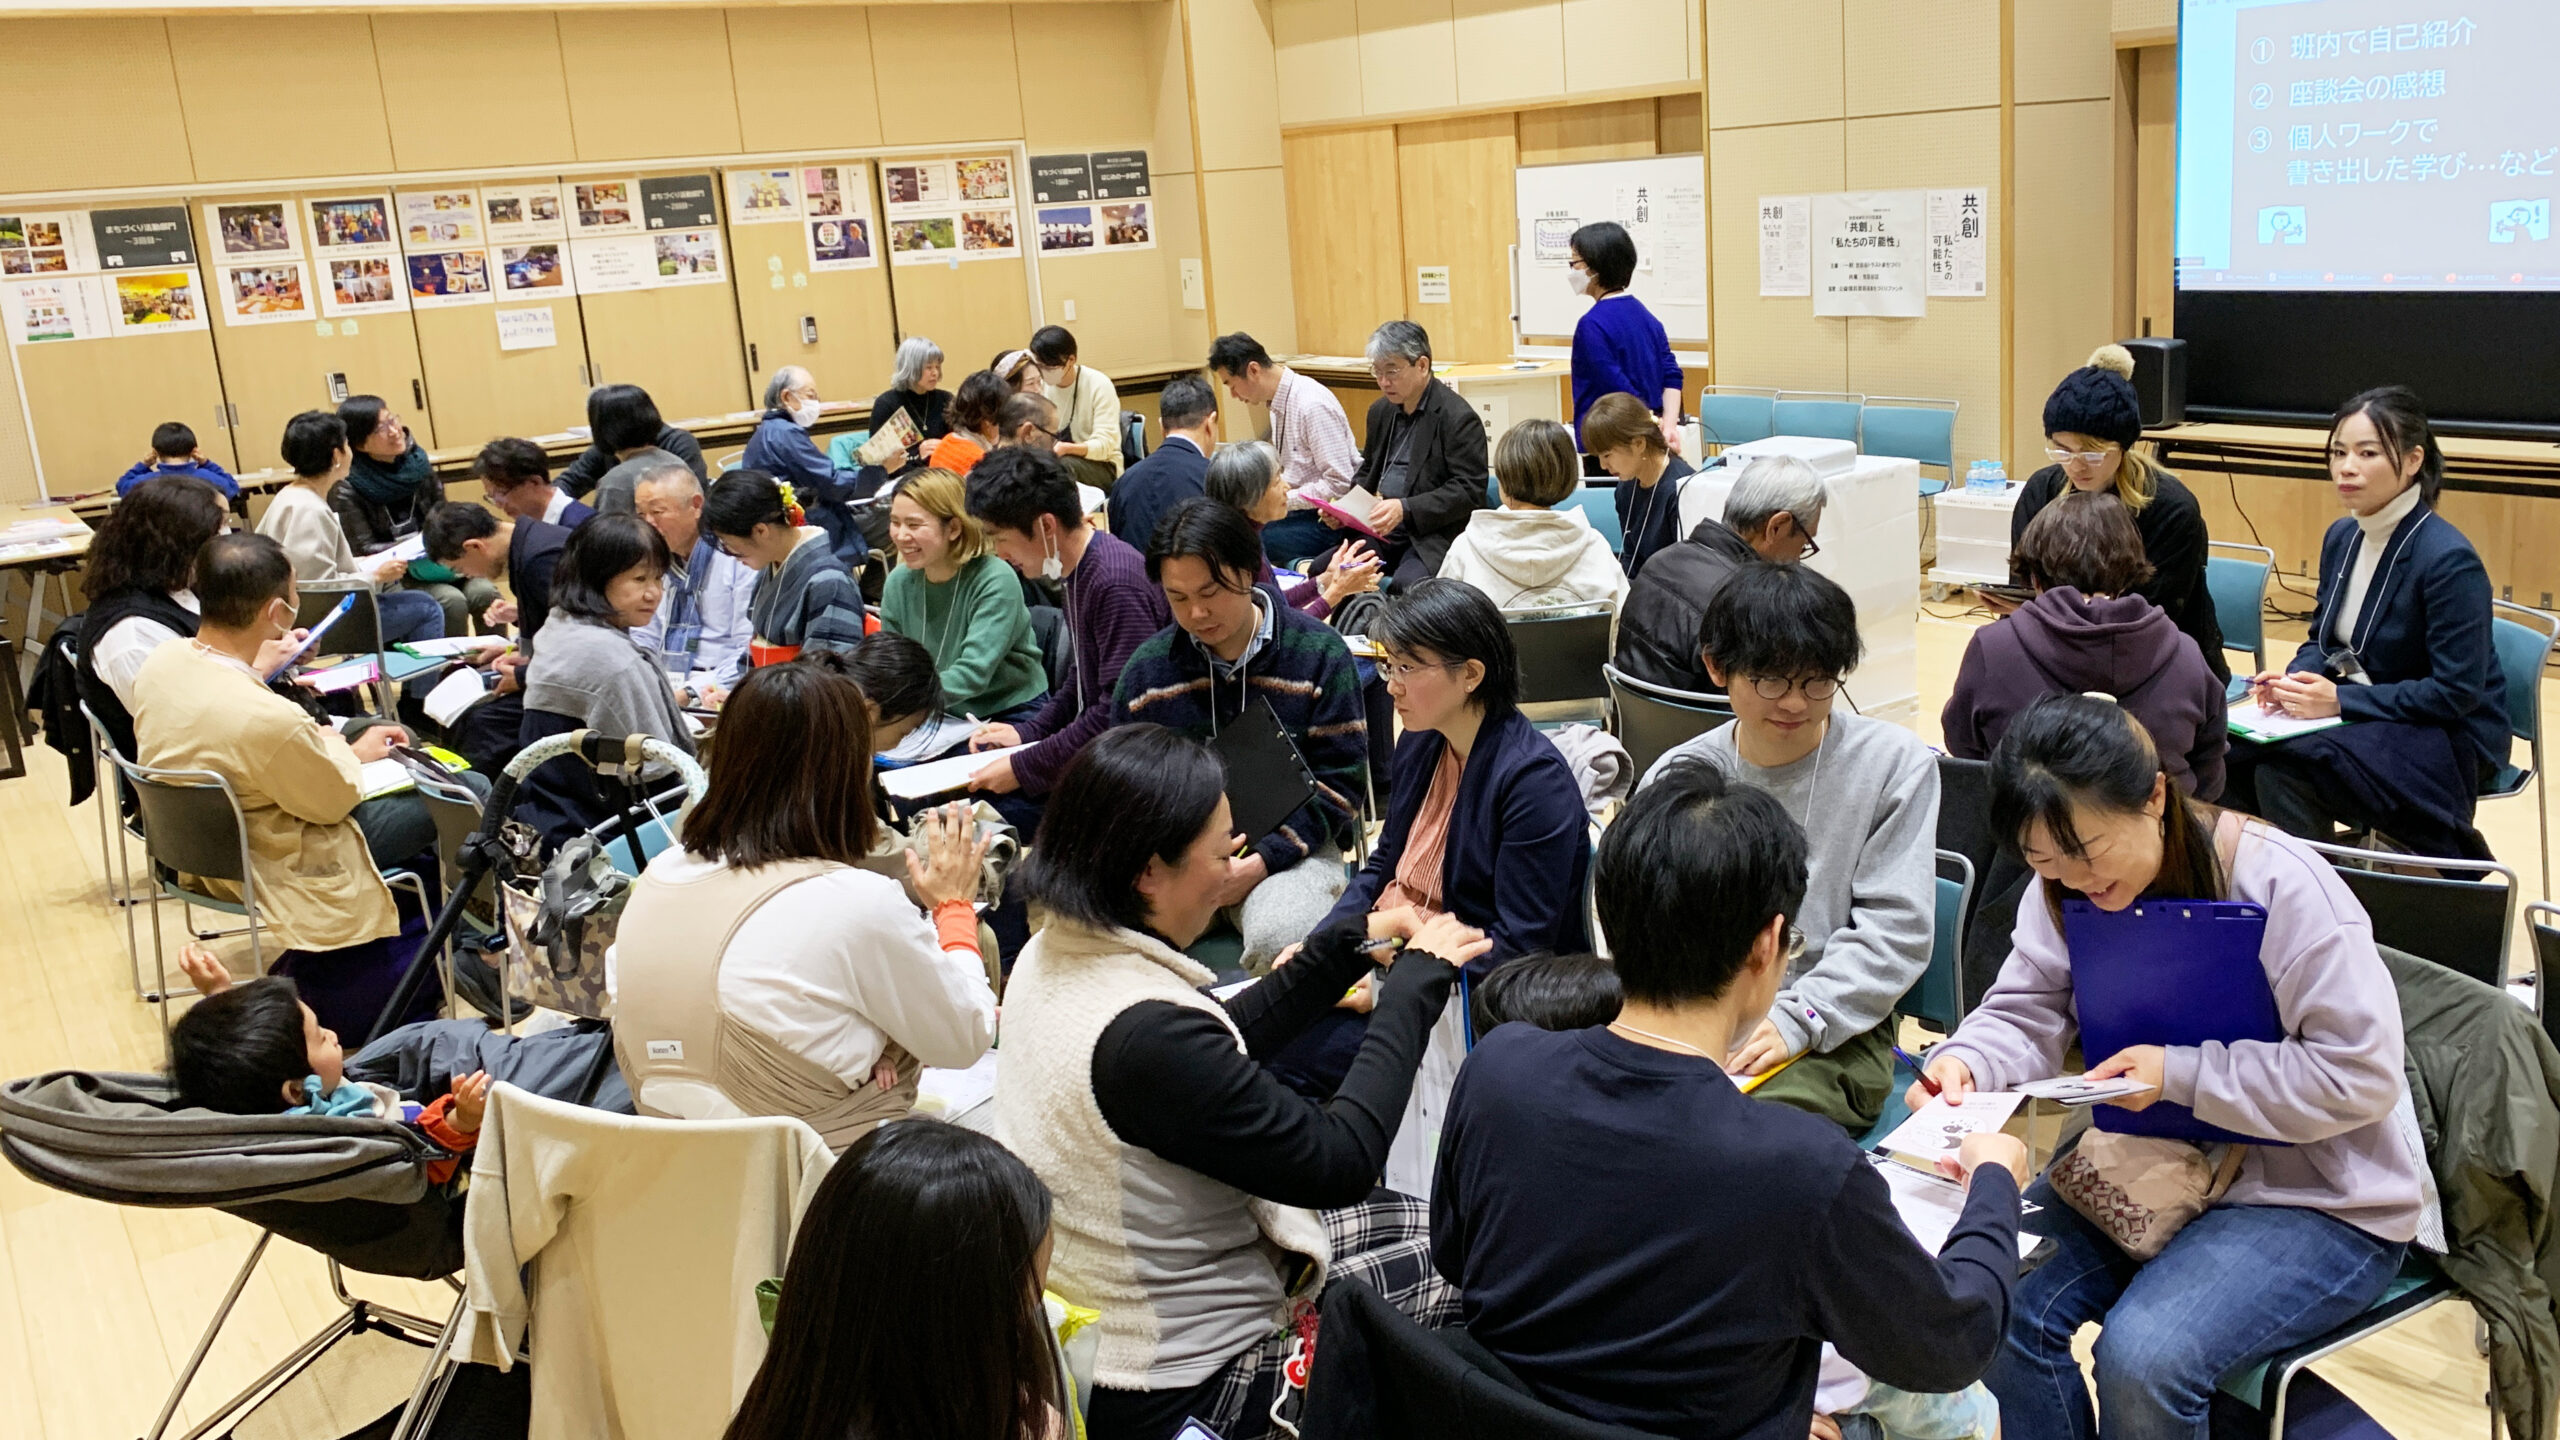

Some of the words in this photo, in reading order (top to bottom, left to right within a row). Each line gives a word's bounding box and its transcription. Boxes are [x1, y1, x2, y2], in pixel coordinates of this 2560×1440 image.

[2250, 37, 2275, 64] ①
[2290, 17, 2477, 60] 班内で自己紹介
[2249, 83, 2274, 109] ②
[2289, 69, 2446, 107] 座談会の感想
[2248, 127, 2272, 152] ③
[2288, 118, 2439, 151] 個人ワークで
[2287, 147, 2559, 185] 書き出した学び…など
[1637, 187, 1648, 223] 共創
[1763, 206, 1783, 220] 共創
[1961, 193, 1979, 239] 共創
[1831, 236, 1900, 248] 「私たちの可能性」
[1932, 235, 1943, 273] 可能性
[1944, 234, 1953, 281] 私たちの
